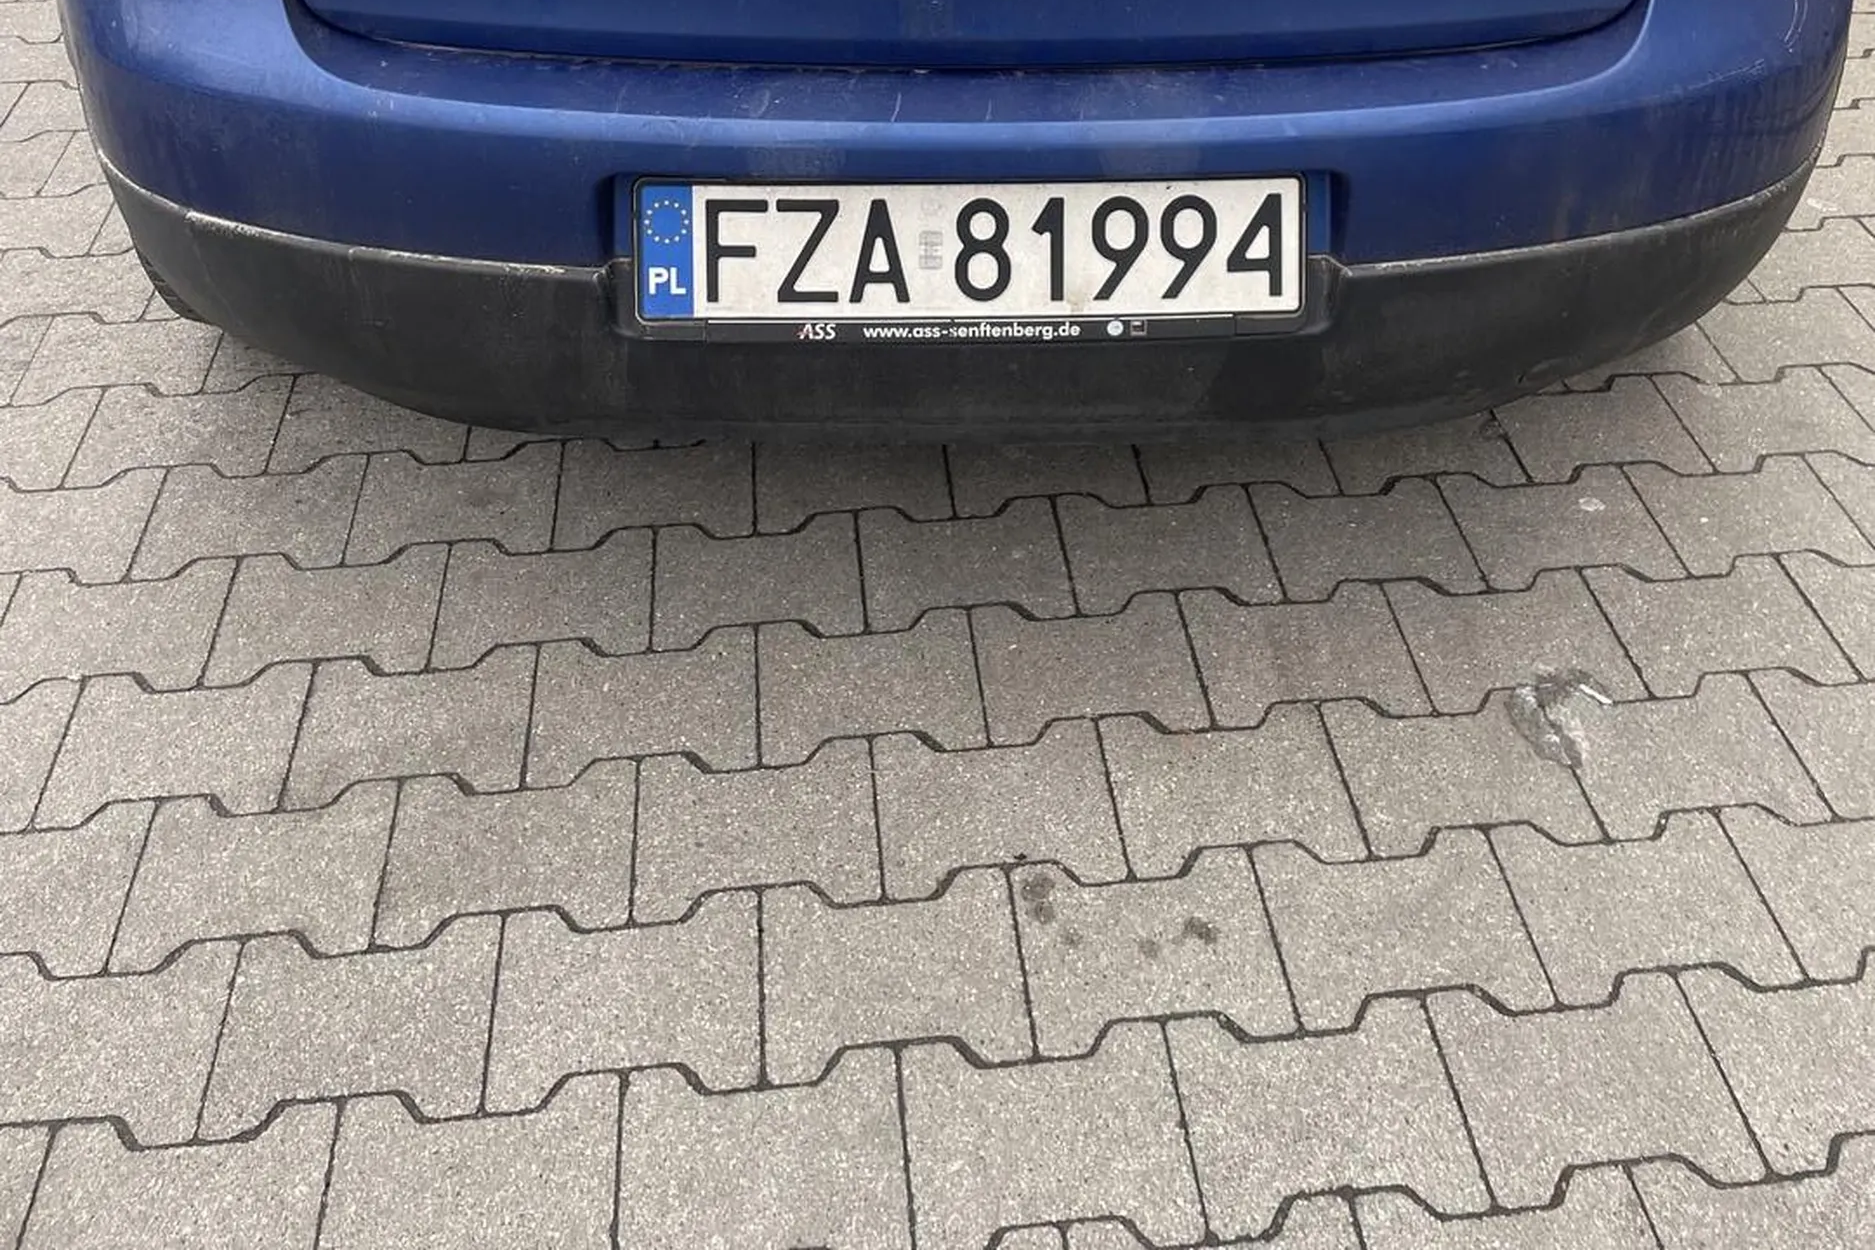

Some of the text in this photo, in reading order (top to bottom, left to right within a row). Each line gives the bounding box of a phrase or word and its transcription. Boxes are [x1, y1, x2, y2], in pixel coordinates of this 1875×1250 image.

[705, 193, 1283, 303] FZA 81994
[648, 266, 687, 295] PL
[798, 322, 1082, 340] ASS www.ass-senftenberg.de
